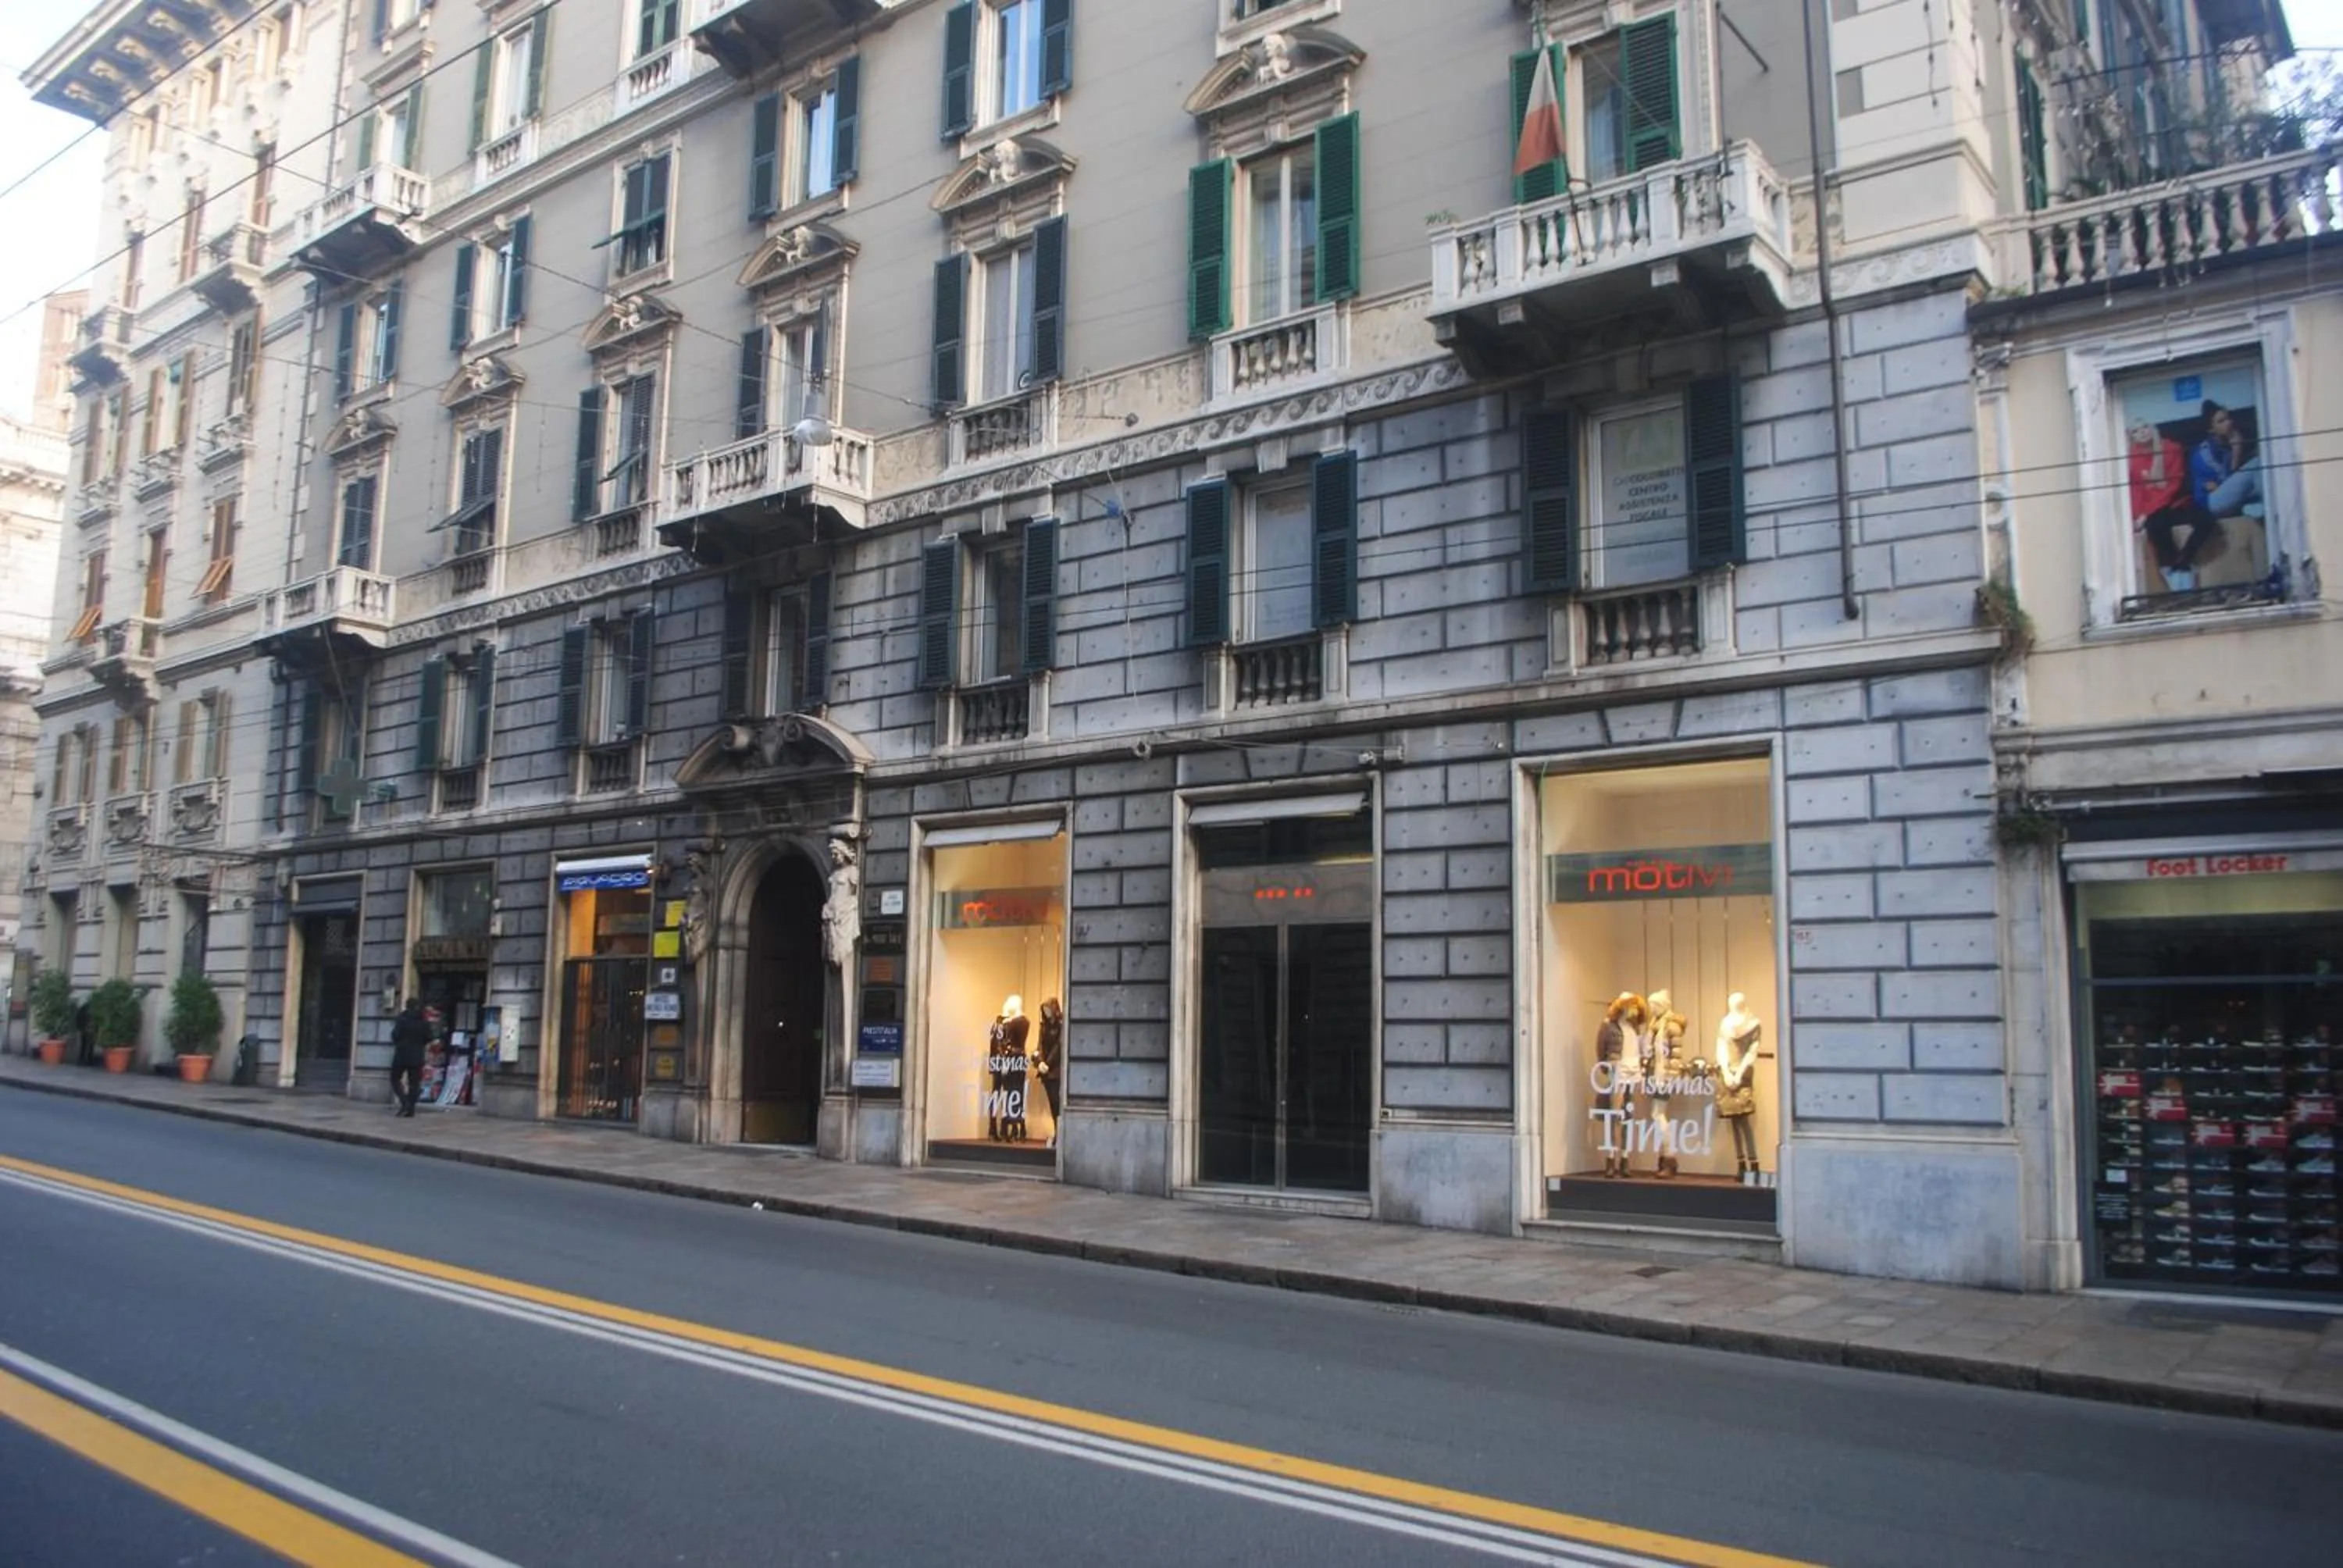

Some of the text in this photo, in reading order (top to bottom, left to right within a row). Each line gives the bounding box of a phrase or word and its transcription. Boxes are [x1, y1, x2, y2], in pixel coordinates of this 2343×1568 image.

[2205, 855, 2288, 875] Locker
[1589, 1060, 1715, 1096] Christmas
[1589, 1102, 1715, 1156] Time!
